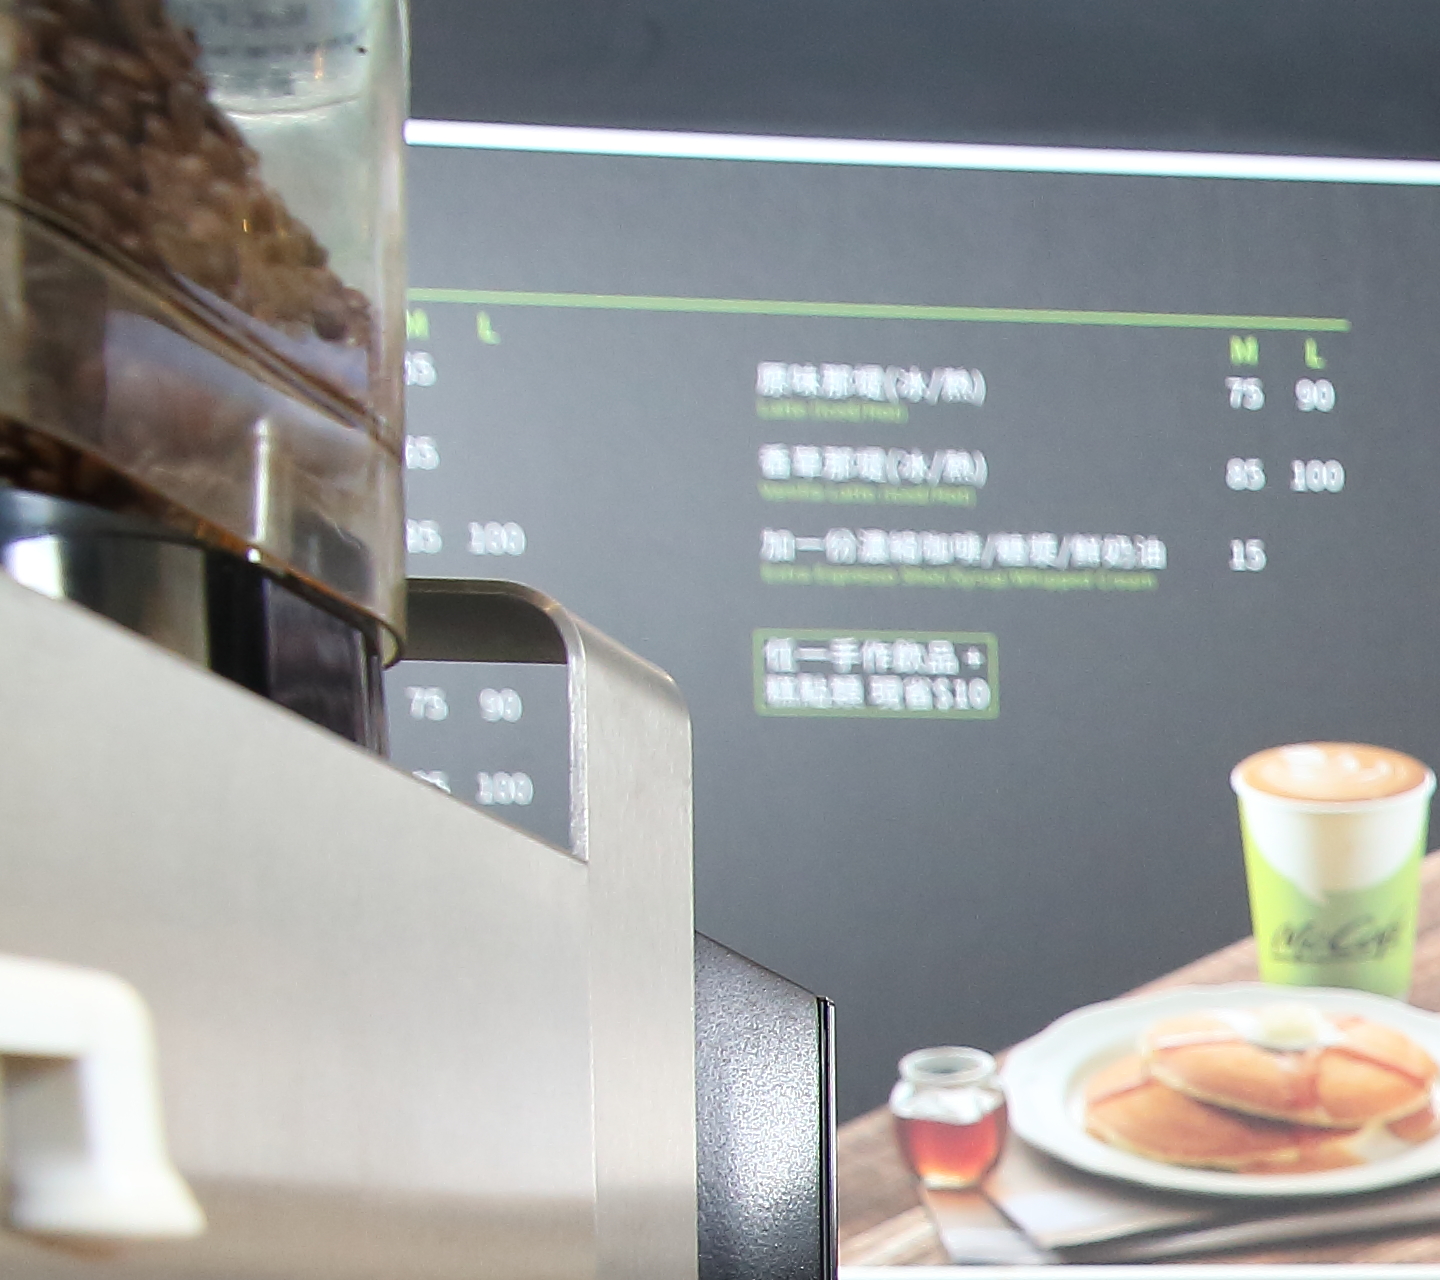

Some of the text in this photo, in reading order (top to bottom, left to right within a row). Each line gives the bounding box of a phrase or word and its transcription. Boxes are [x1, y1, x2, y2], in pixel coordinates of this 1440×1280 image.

[476, 311, 500, 345] L
[1229, 335, 1326, 371] M L
[1225, 375, 1336, 412] 75 90
[1226, 457, 1345, 493] 85 100
[468, 521, 527, 555] 100
[1229, 538, 1266, 571] 15
[404, 686, 523, 722] 75 90
[475, 771, 534, 805] 100
